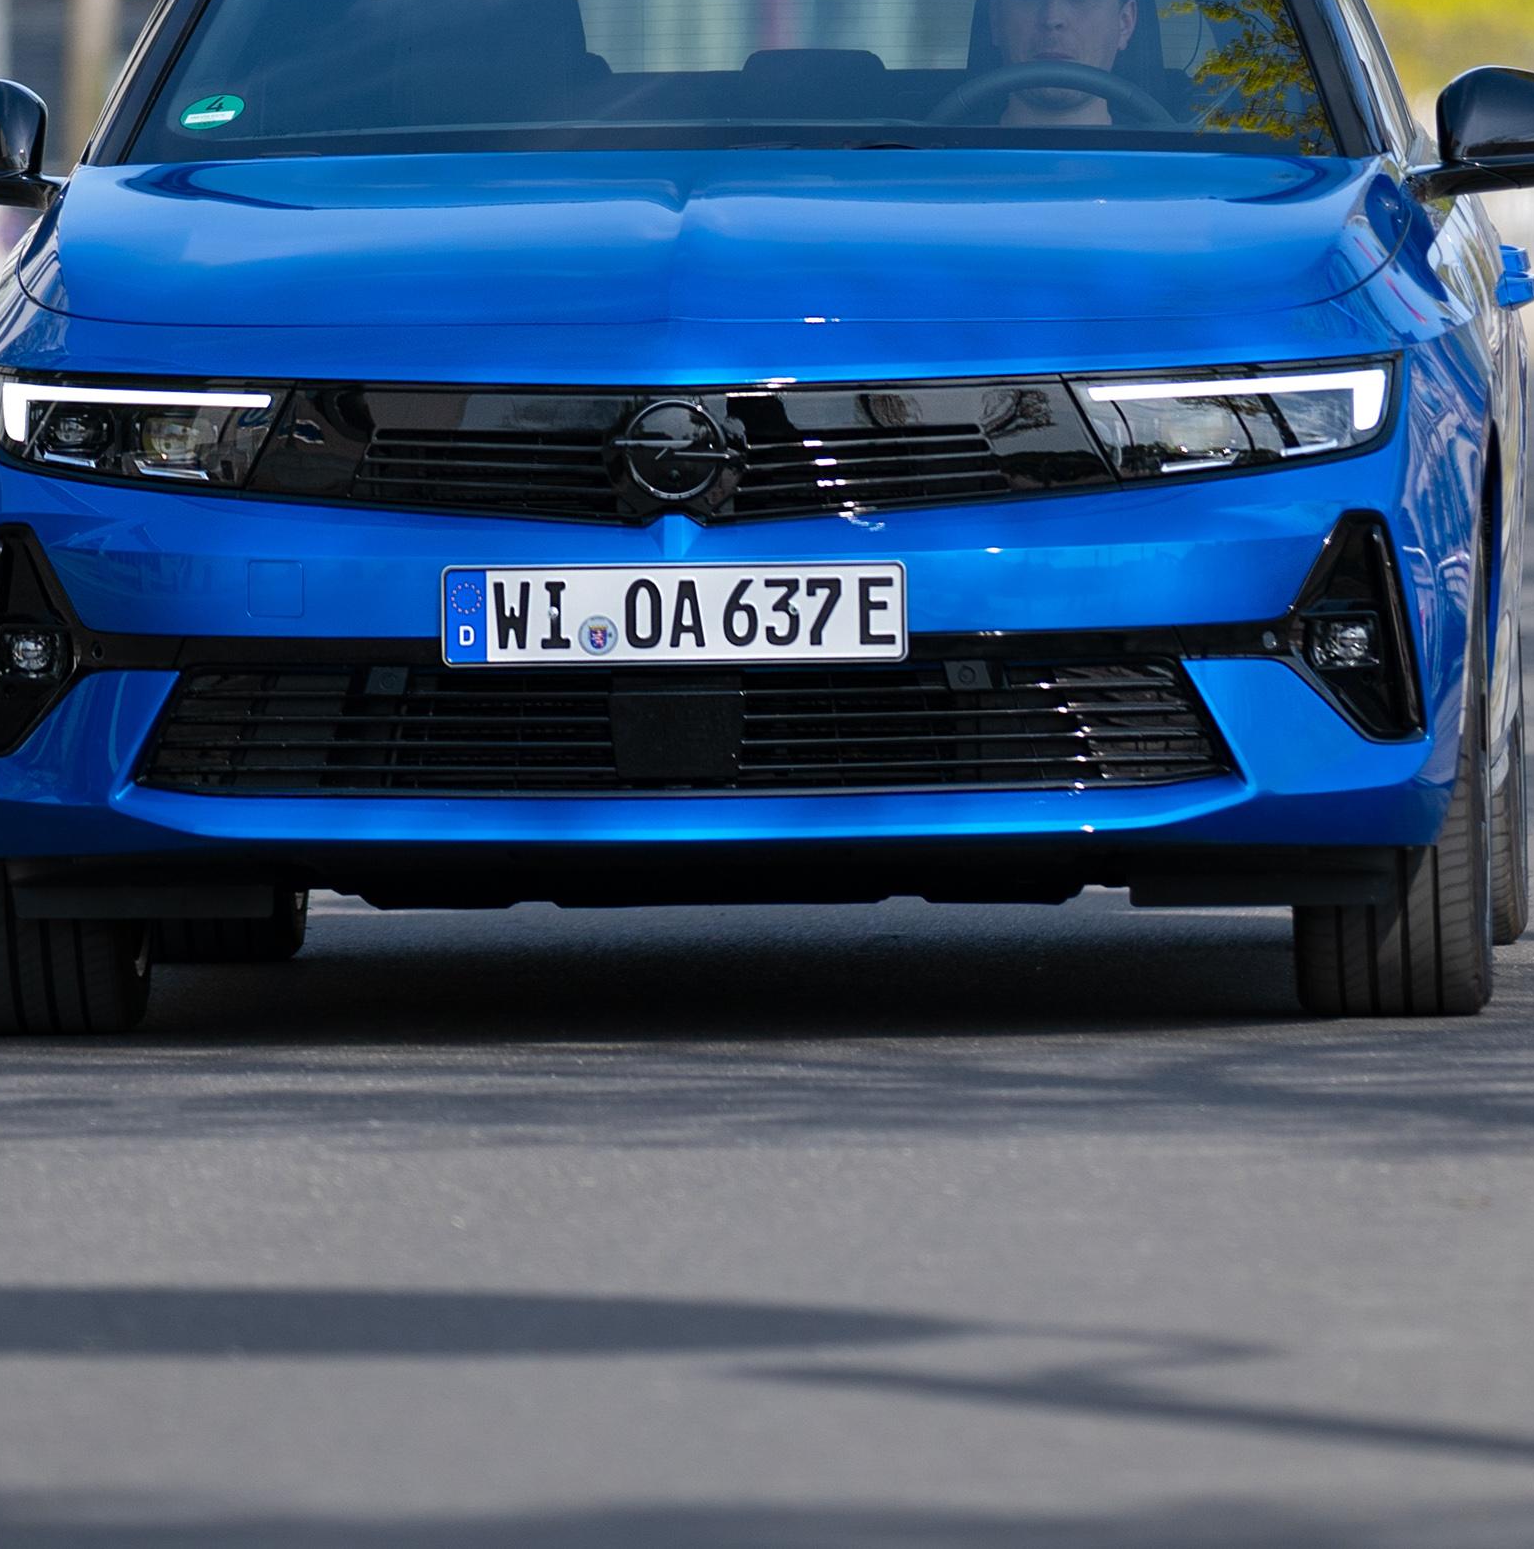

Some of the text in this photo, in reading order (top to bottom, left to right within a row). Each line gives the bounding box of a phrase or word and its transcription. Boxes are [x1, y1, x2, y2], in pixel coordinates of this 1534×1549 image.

[206, 96, 225, 112] 4
[493, 581, 571, 650] WI
[459, 625, 475, 647] D
